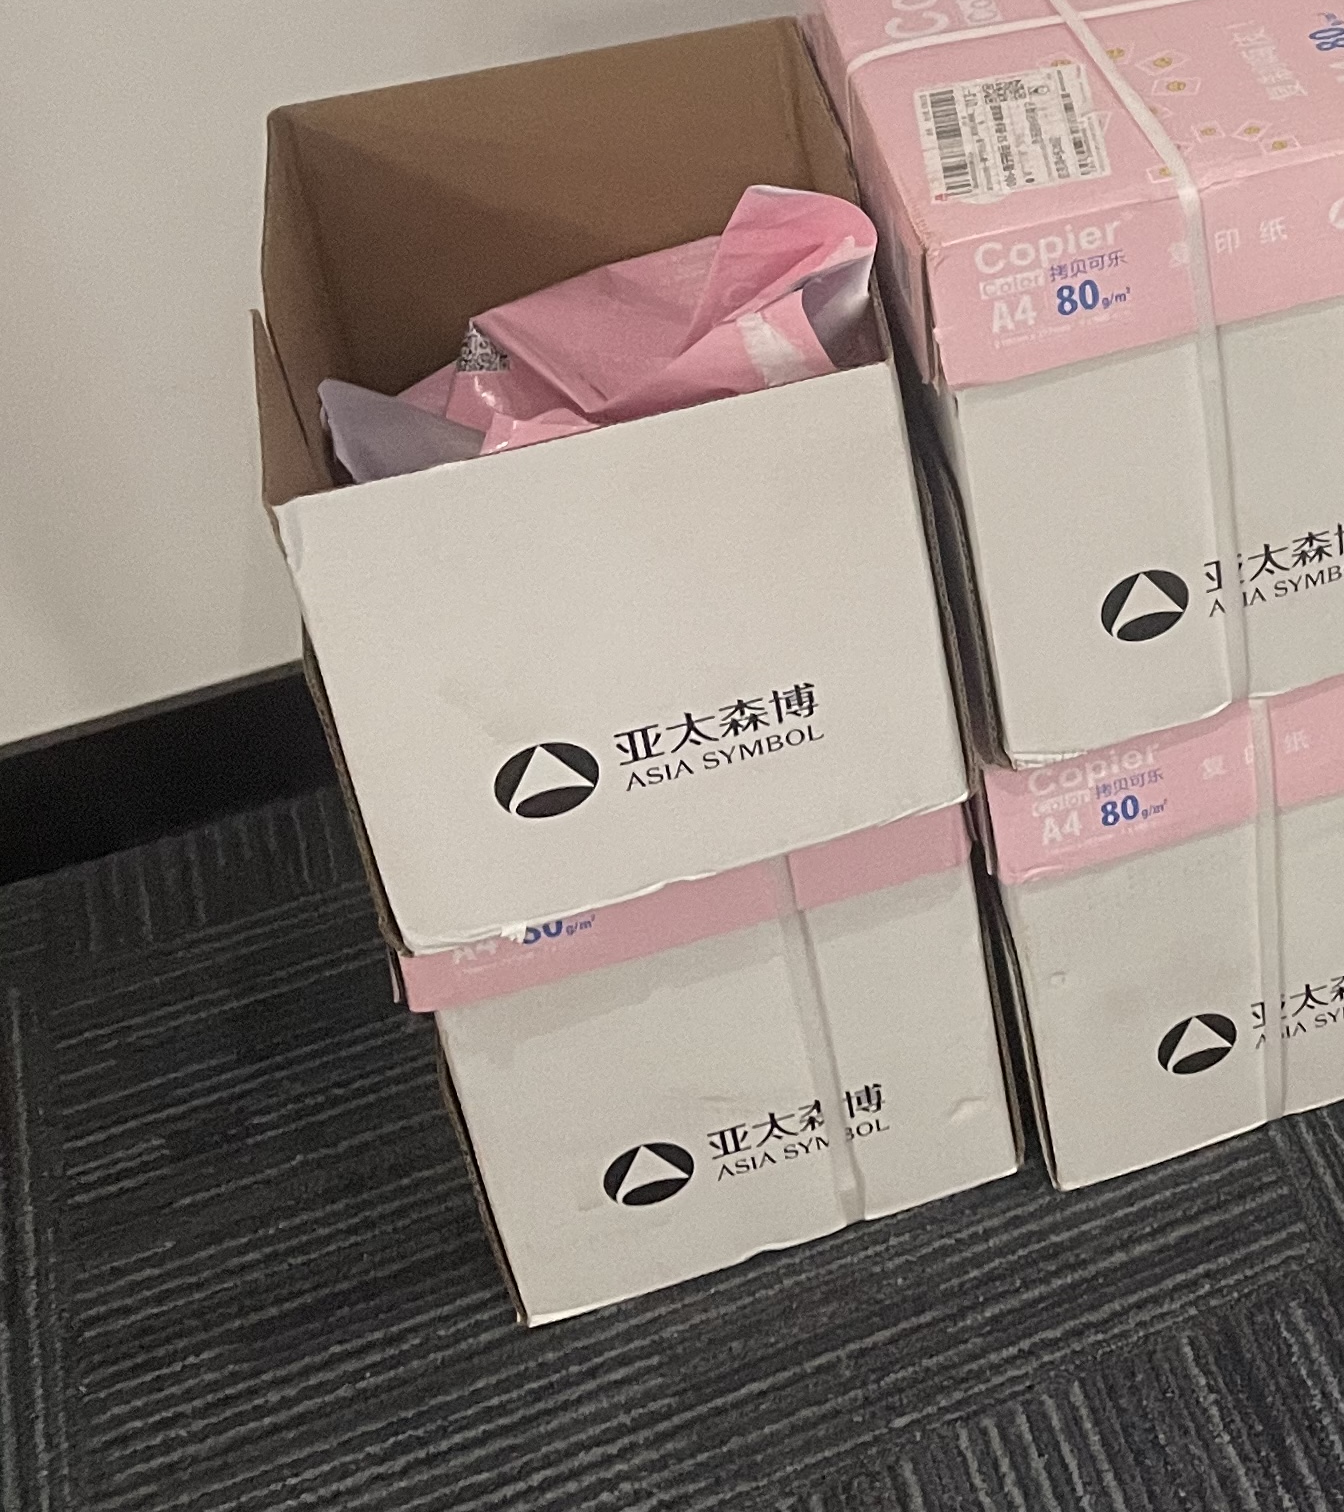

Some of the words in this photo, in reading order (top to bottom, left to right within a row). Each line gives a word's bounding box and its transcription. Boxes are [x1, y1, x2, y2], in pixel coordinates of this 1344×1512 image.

[974, 220, 1121, 274] Copier
[1050, 248, 1129, 282] 拷贝可乐
[991, 293, 1037, 334] A4
[1208, 586, 1267, 618] AIA
[614, 682, 819, 766] 亚太森博
[626, 759, 694, 792] ASIA
[702, 724, 825, 770] SYMBOL
[1042, 810, 1082, 846] A4
[1255, 1021, 1307, 1049] AIA
[717, 1151, 777, 1182] ASIA
